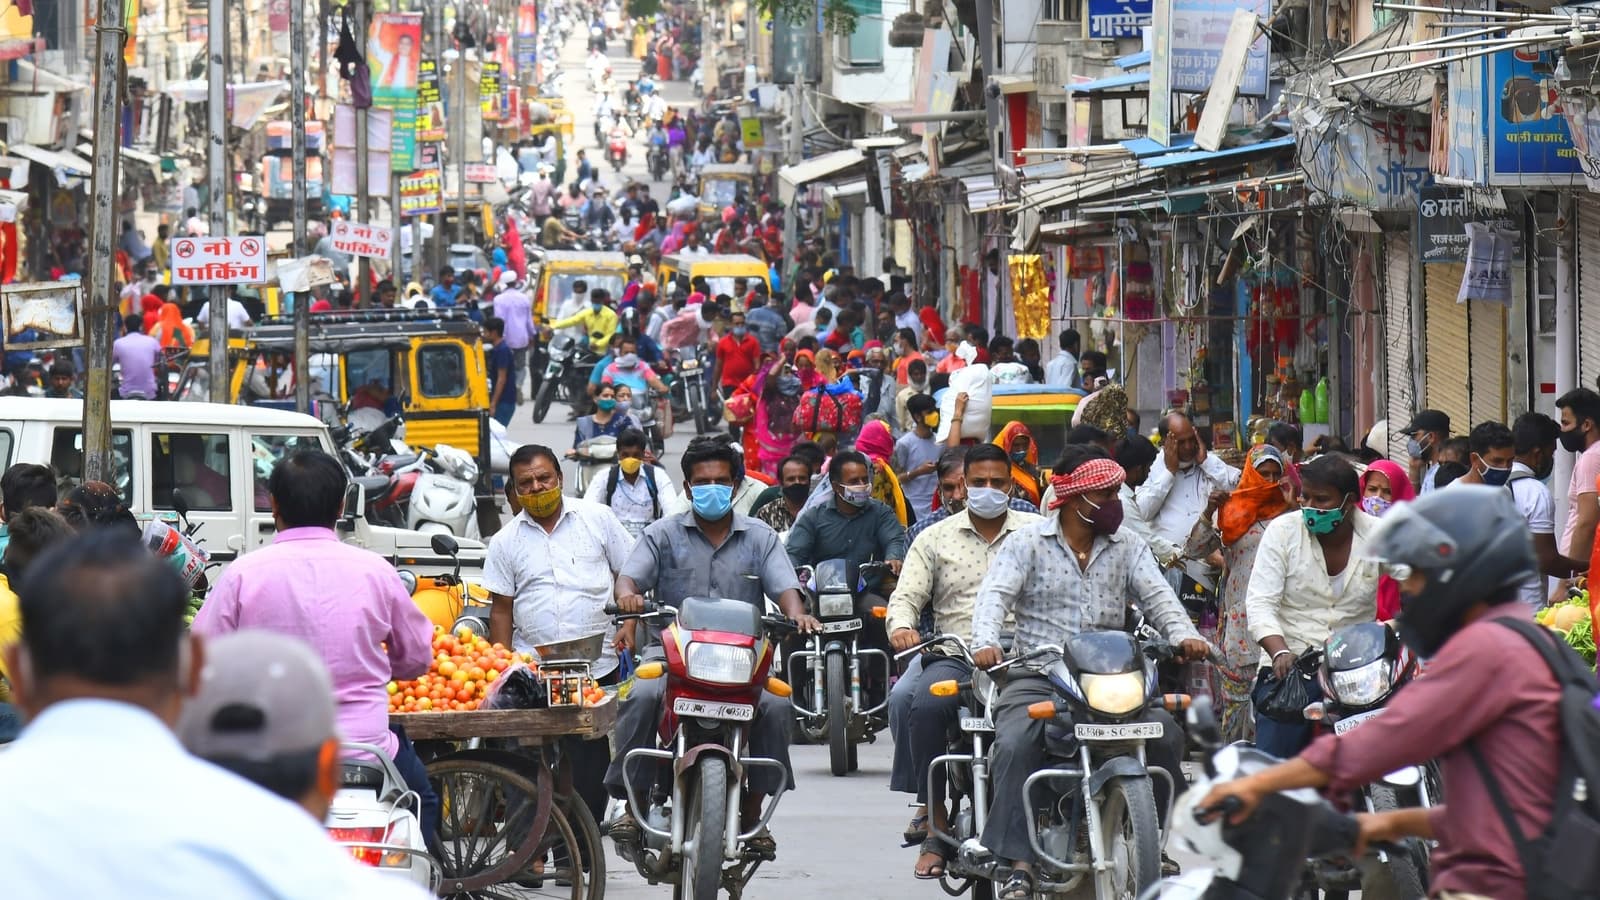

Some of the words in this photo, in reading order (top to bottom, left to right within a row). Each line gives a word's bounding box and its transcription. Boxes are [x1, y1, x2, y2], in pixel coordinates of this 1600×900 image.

[1506, 131, 1531, 142] पाली
[1533, 133, 1567, 143] बाजार,
[202, 238, 232, 256] नो
[177, 261, 259, 281] पार्किंग
[1110, 727, 1127, 737] SC
